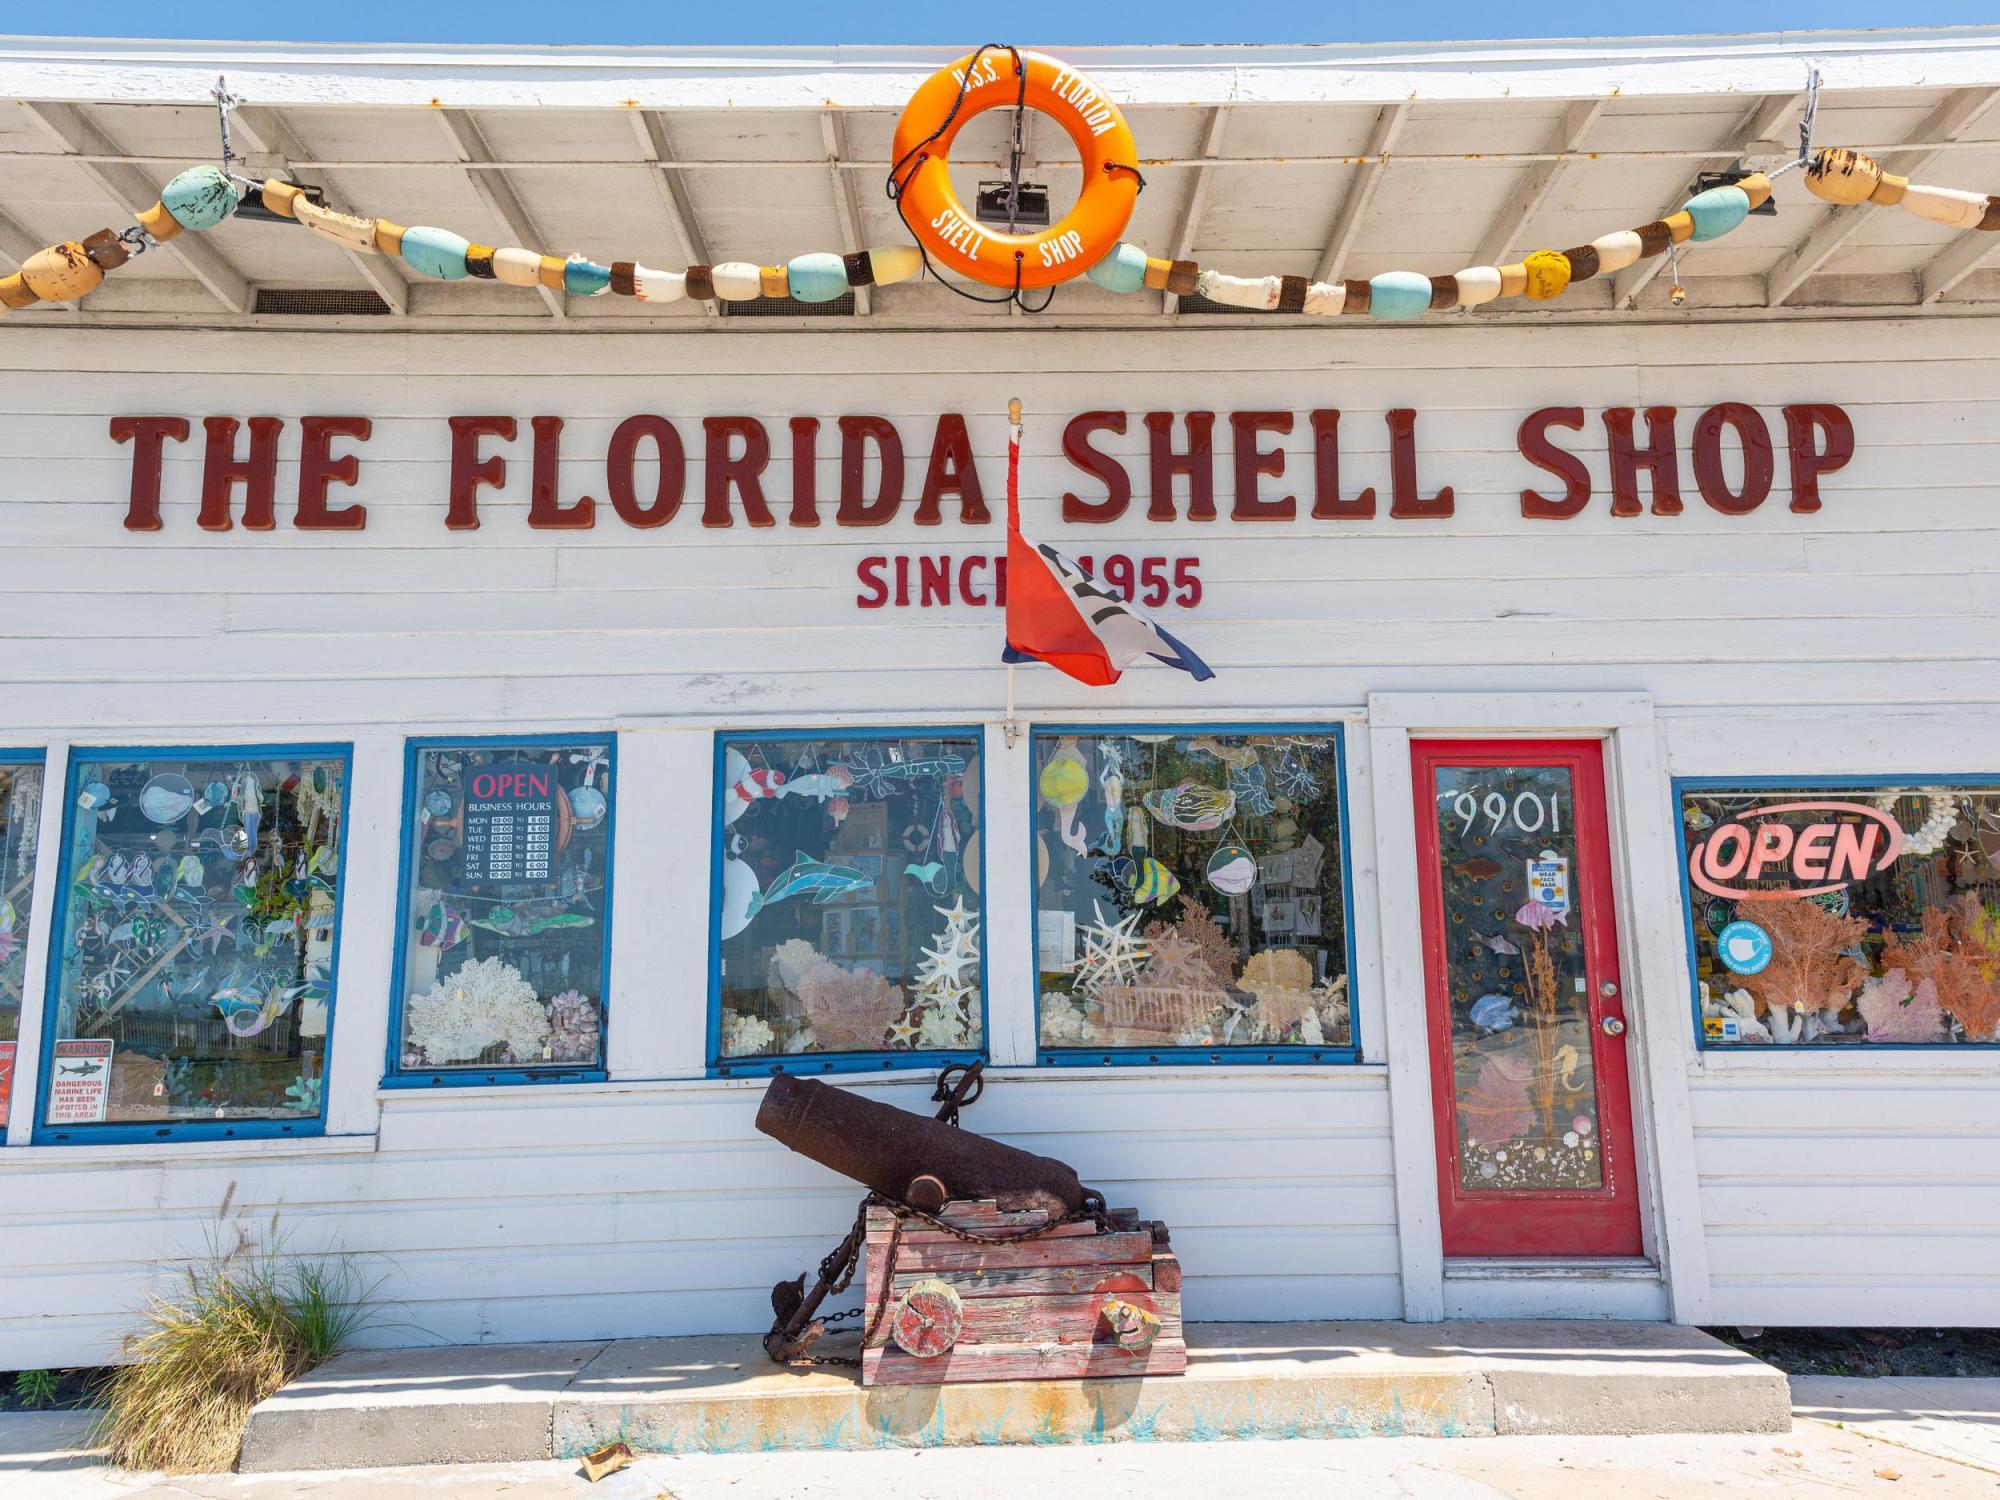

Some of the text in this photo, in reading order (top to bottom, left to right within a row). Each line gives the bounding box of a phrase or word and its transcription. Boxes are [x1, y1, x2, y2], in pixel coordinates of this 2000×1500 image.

[1051, 70, 1117, 136] FLORIDA
[931, 209, 1085, 267] SHELL SHOP
[111, 403, 1854, 531] THE FLORIDA SHELL SHOP
[473, 773, 548, 798] OPEN
[468, 802, 551, 811] BUSINESS HOURS
[468, 817, 488, 825] MON
[1453, 791, 1559, 838] 9901
[1704, 823, 1880, 880] OPEN
[56, 1043, 110, 1054] WARNING
[74, 1111, 96, 1119] AREA!
